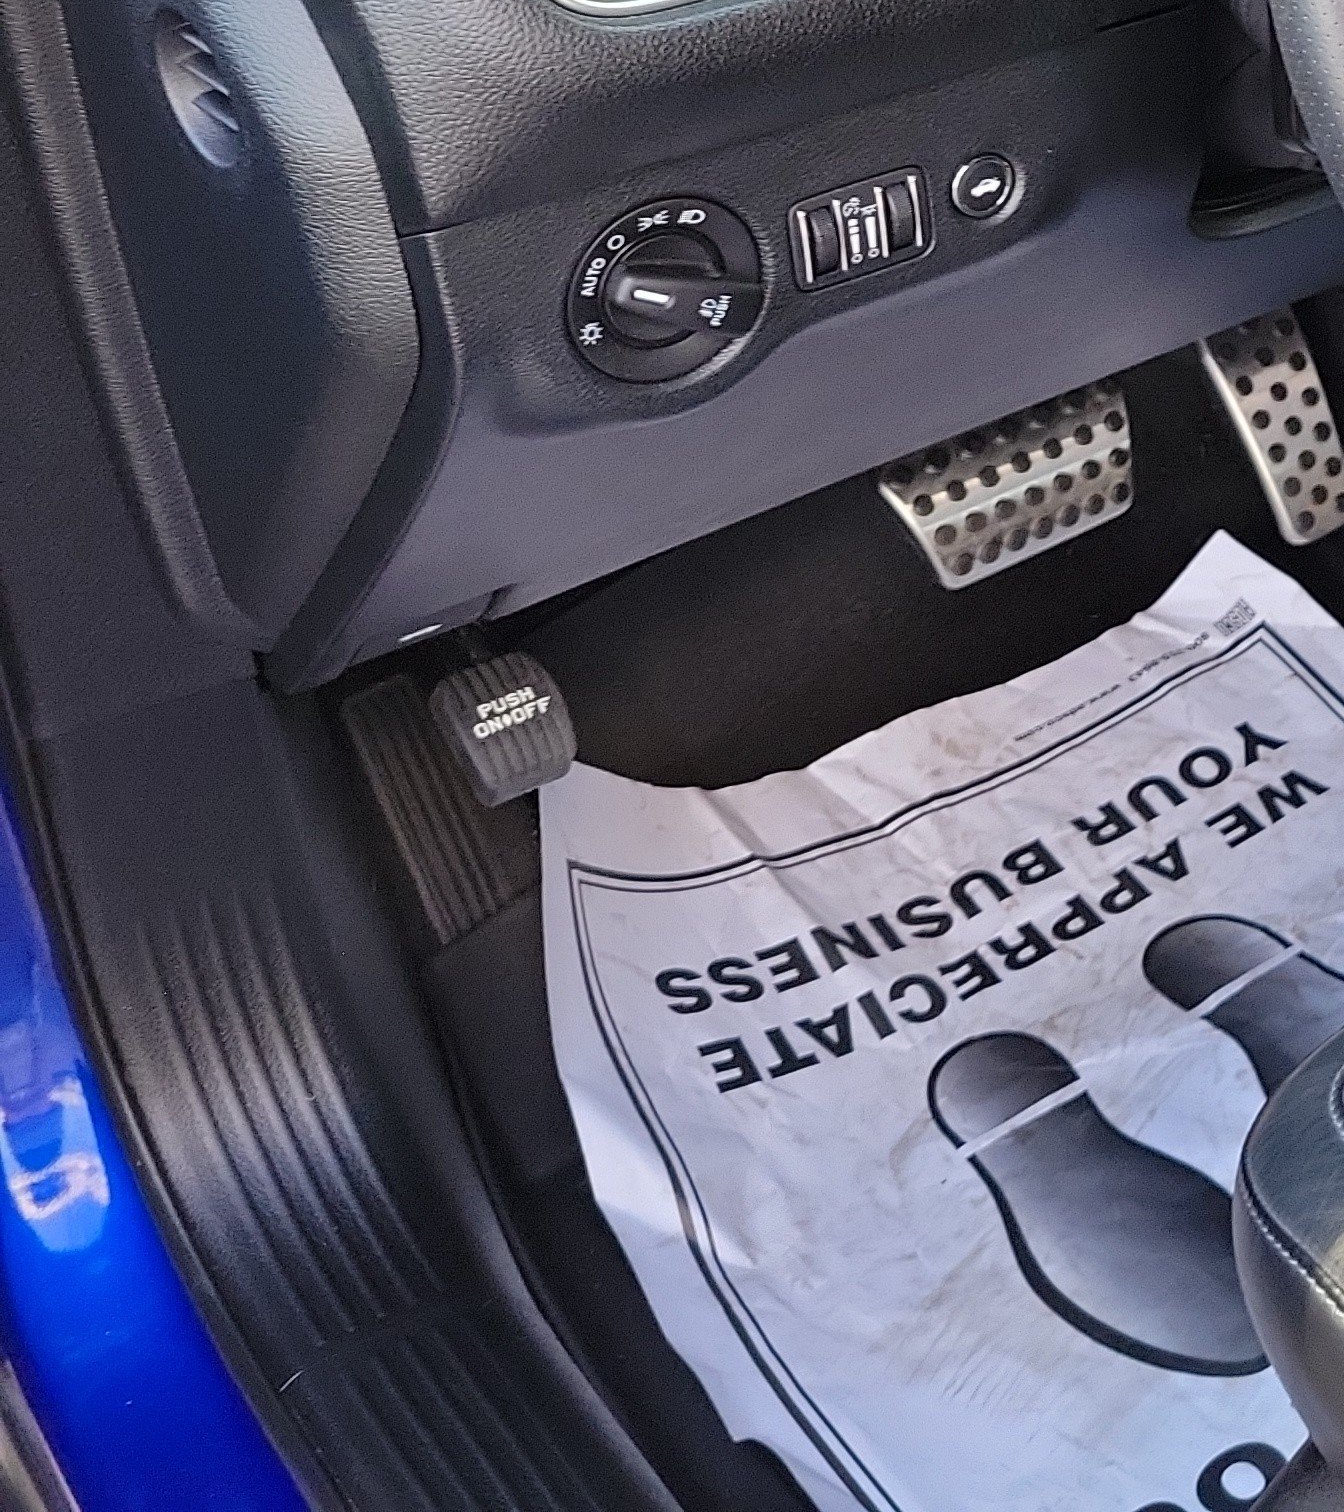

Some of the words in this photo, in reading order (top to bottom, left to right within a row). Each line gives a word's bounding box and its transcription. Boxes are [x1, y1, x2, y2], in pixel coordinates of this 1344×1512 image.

[580, 257, 607, 297] AUTO
[709, 294, 733, 327] PUSH
[476, 686, 537, 720] PUSH
[1072, 721, 1288, 848] YOUR
[1203, 768, 1331, 849] WE
[654, 838, 1065, 1016] BUSINESS
[697, 838, 1191, 1094] APPRECIATE
